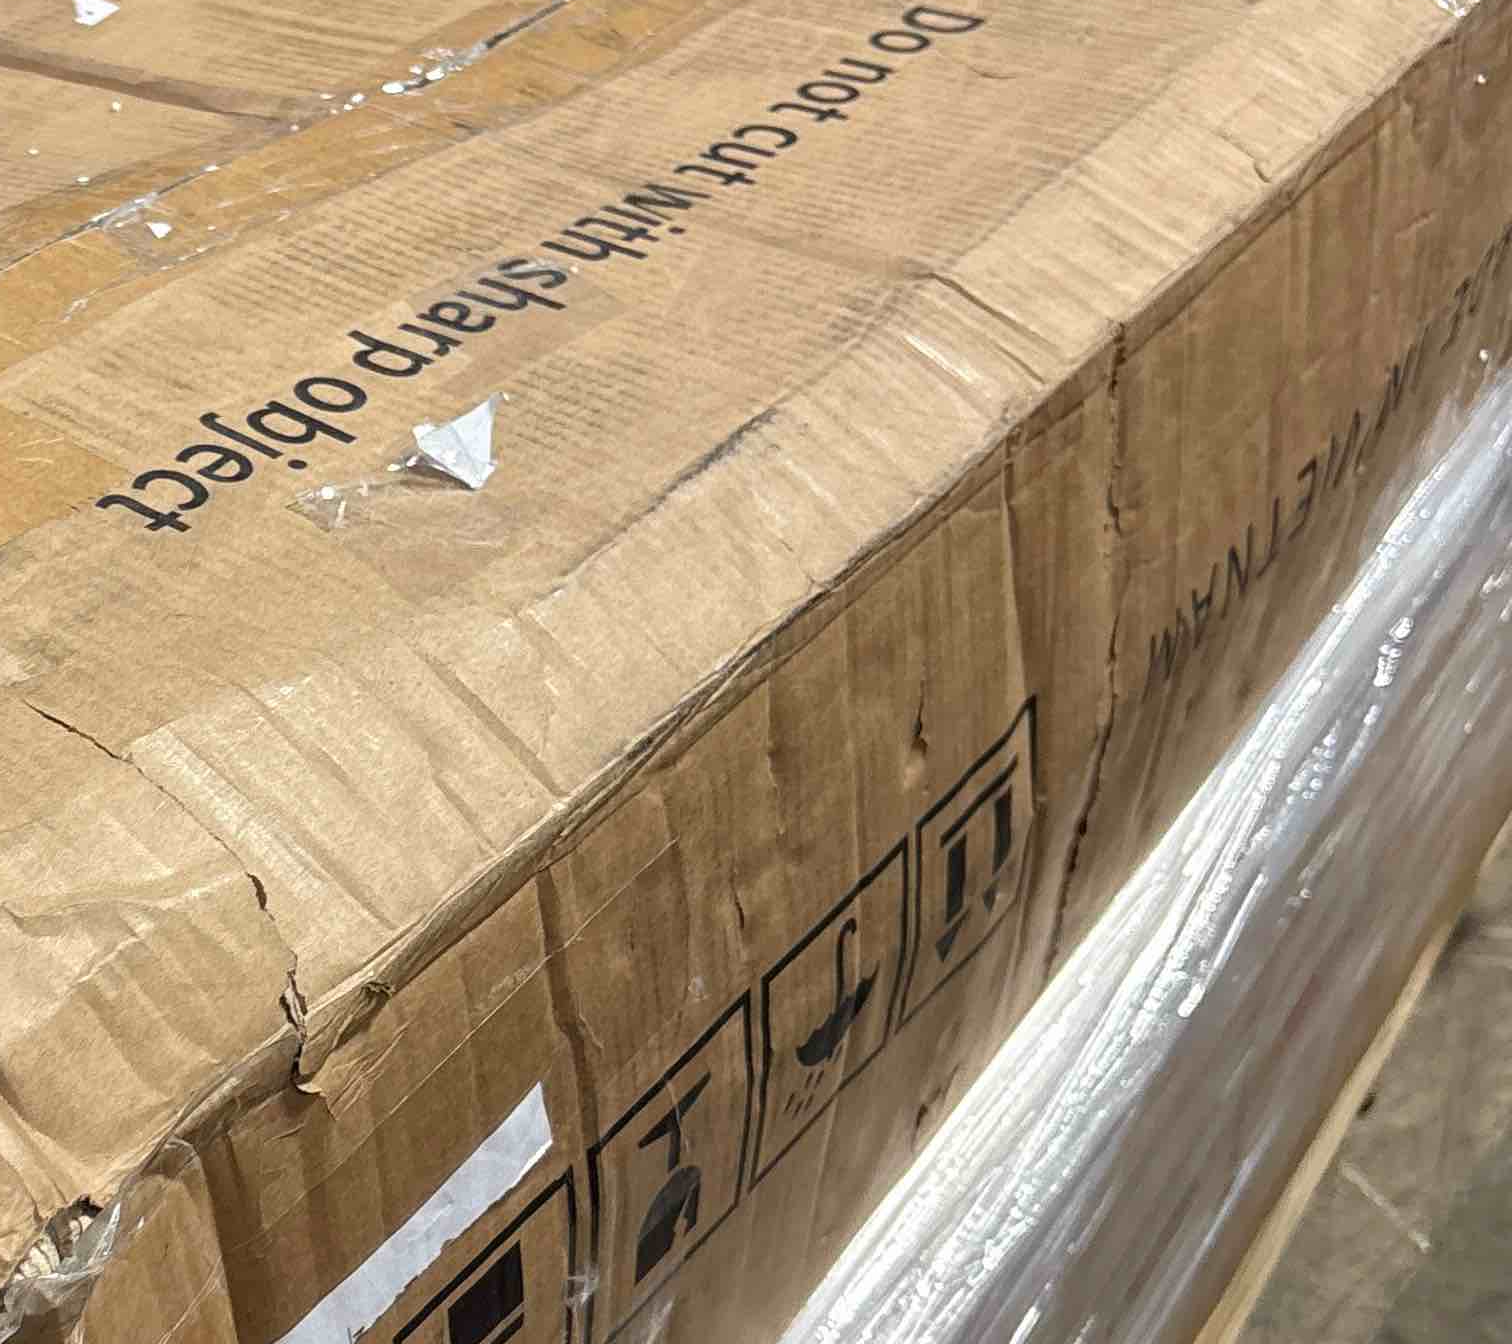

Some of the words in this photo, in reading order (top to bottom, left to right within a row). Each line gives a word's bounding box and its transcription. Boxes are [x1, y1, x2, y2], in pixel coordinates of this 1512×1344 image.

[868, 5, 986, 53] Do
[768, 57, 896, 123] not
[674, 123, 798, 186] cut
[540, 183, 712, 260] with
[347, 258, 568, 378] sharp
[94, 376, 368, 534] object
